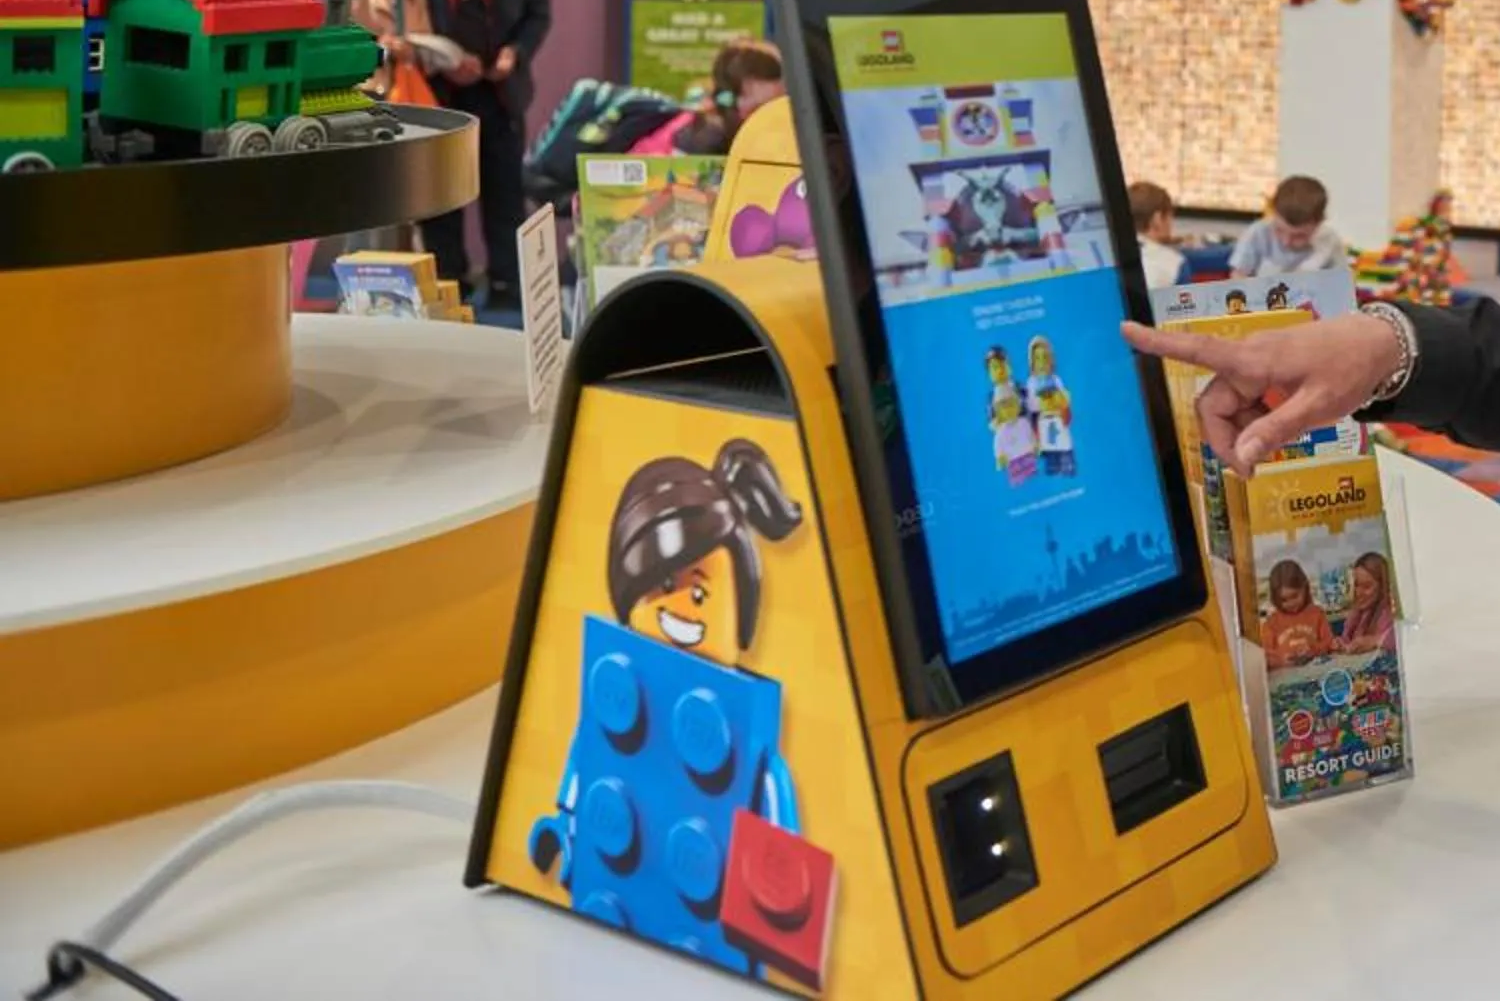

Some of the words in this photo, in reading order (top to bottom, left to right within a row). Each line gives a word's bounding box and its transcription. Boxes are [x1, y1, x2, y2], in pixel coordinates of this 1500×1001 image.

[1289, 485, 1367, 512] LEGOLAND
[1283, 754, 1349, 784] RESORT
[1351, 742, 1401, 768] GUIDE
